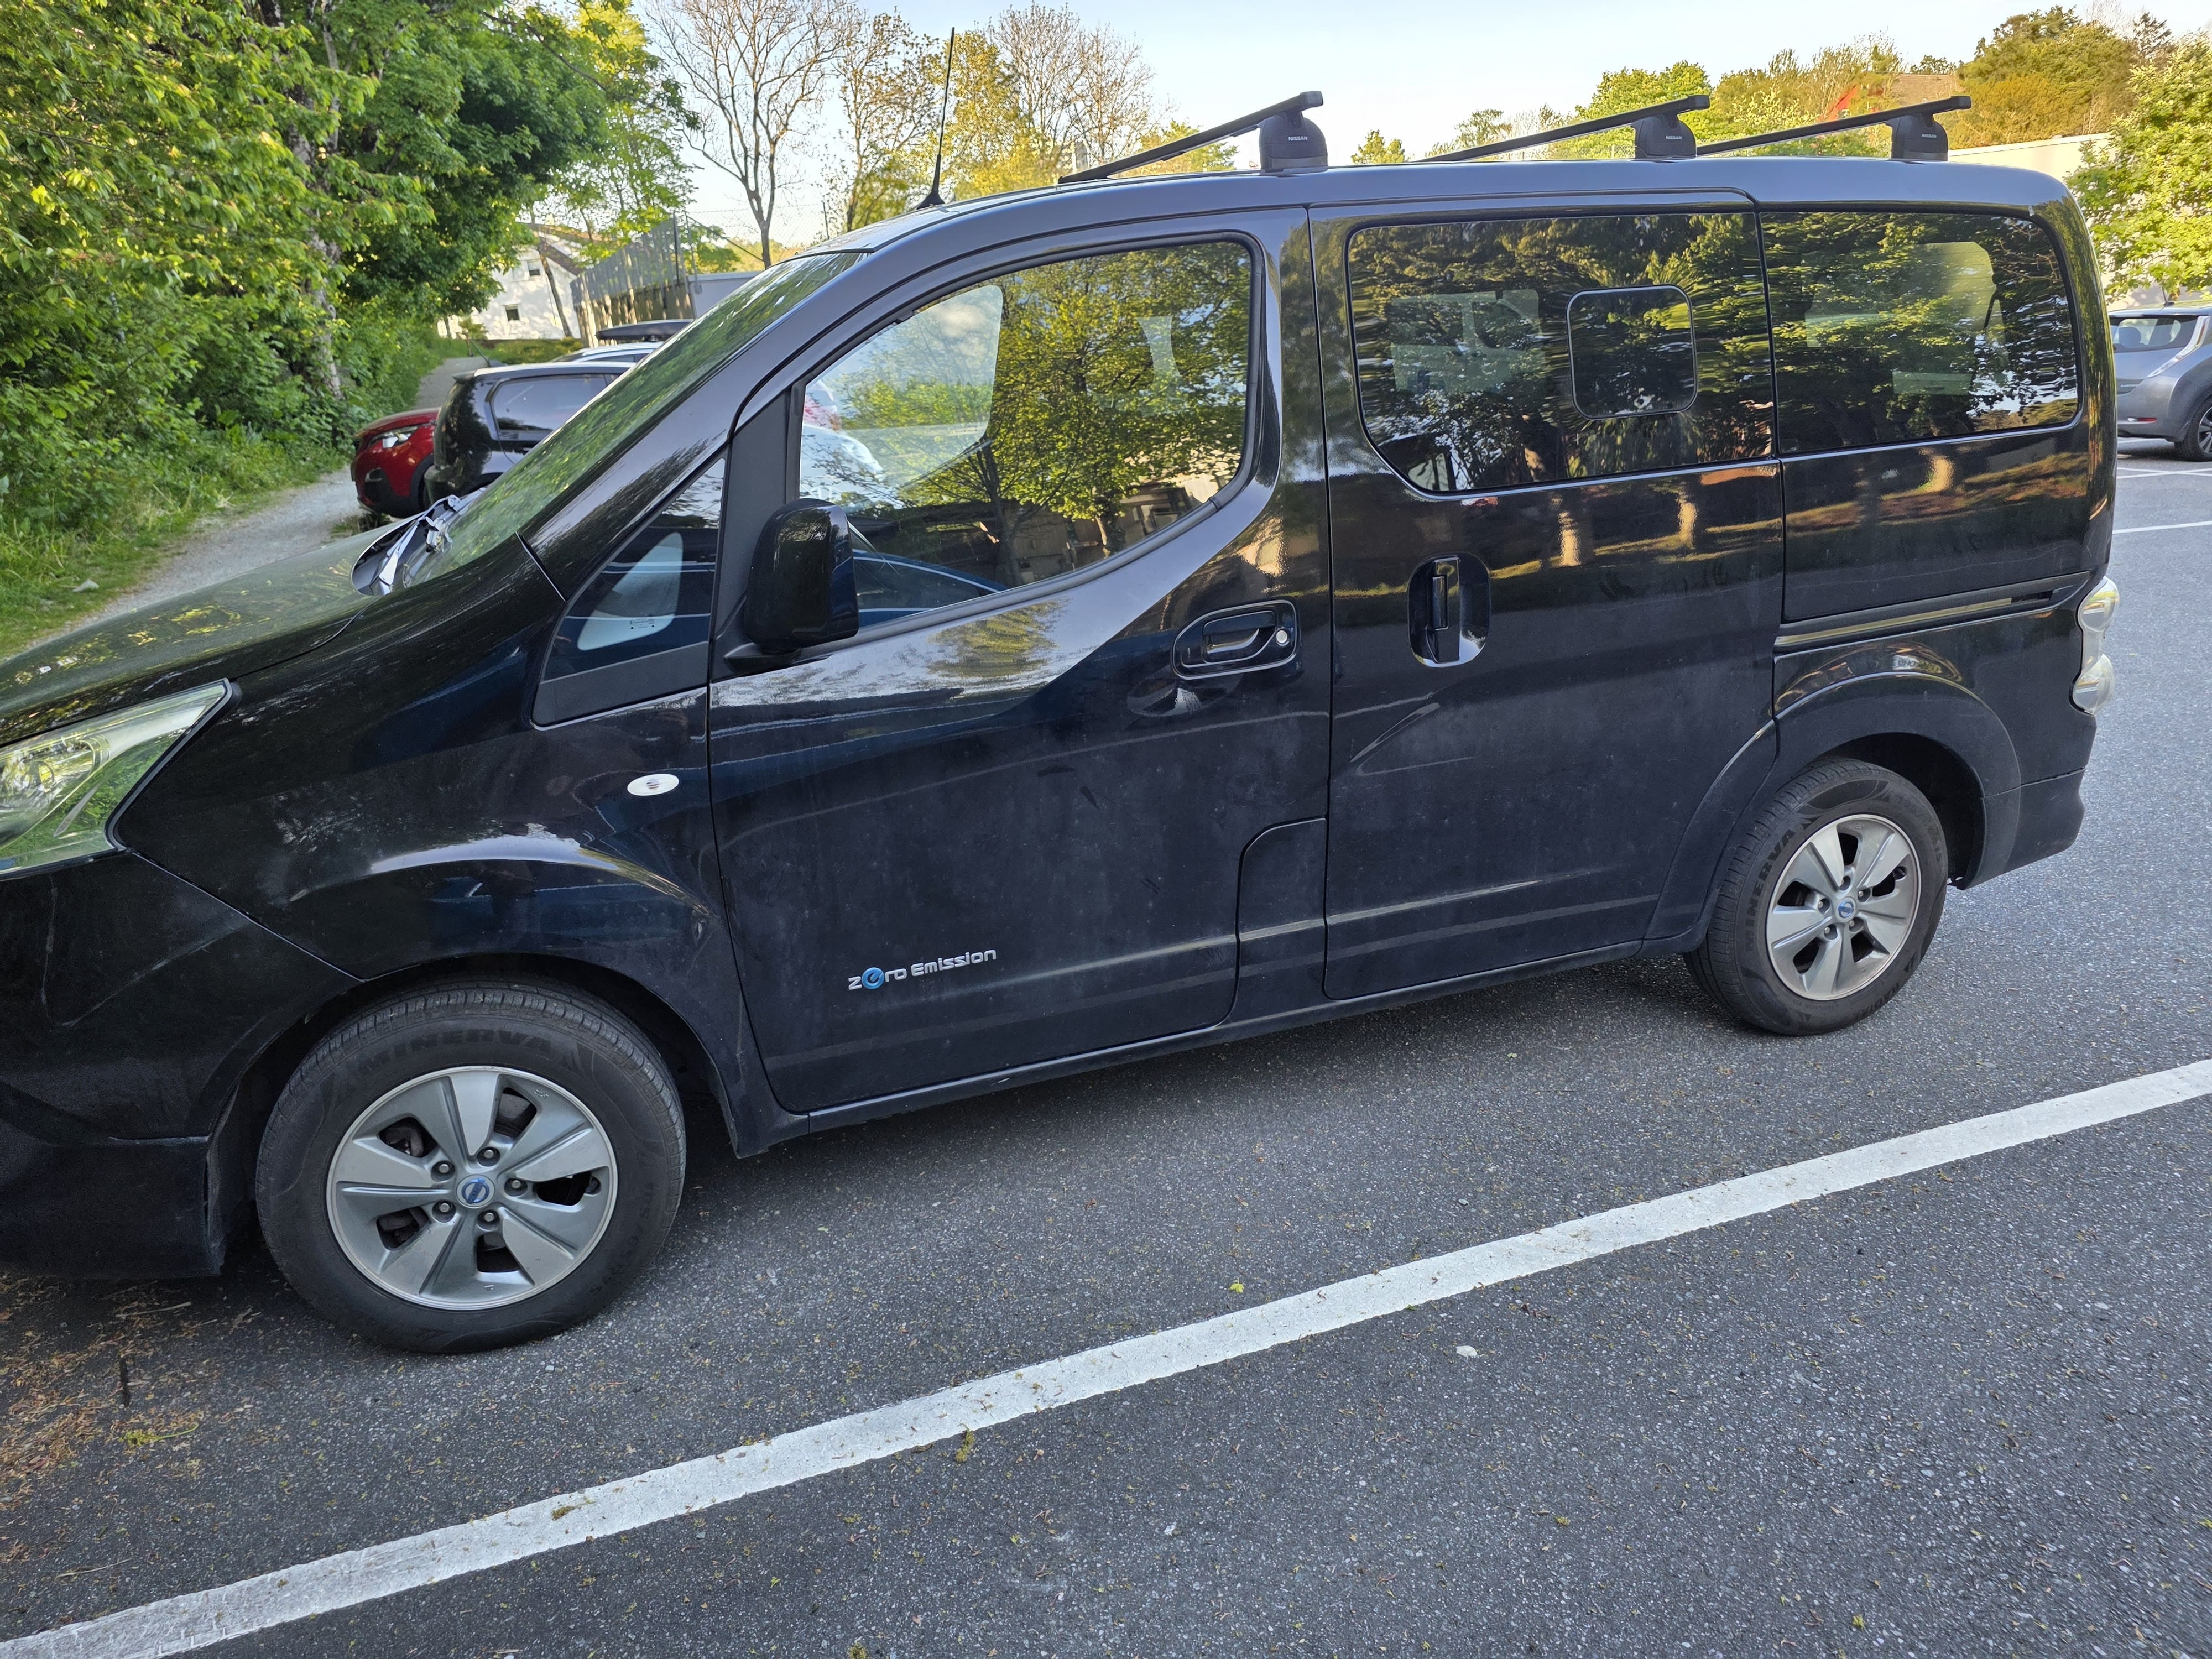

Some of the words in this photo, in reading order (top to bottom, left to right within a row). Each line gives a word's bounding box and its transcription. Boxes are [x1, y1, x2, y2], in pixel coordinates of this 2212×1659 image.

[1745, 829, 1796, 952] MINERVA
[911, 949, 997, 977] Emission
[357, 1029, 551, 1074] MINERVA
